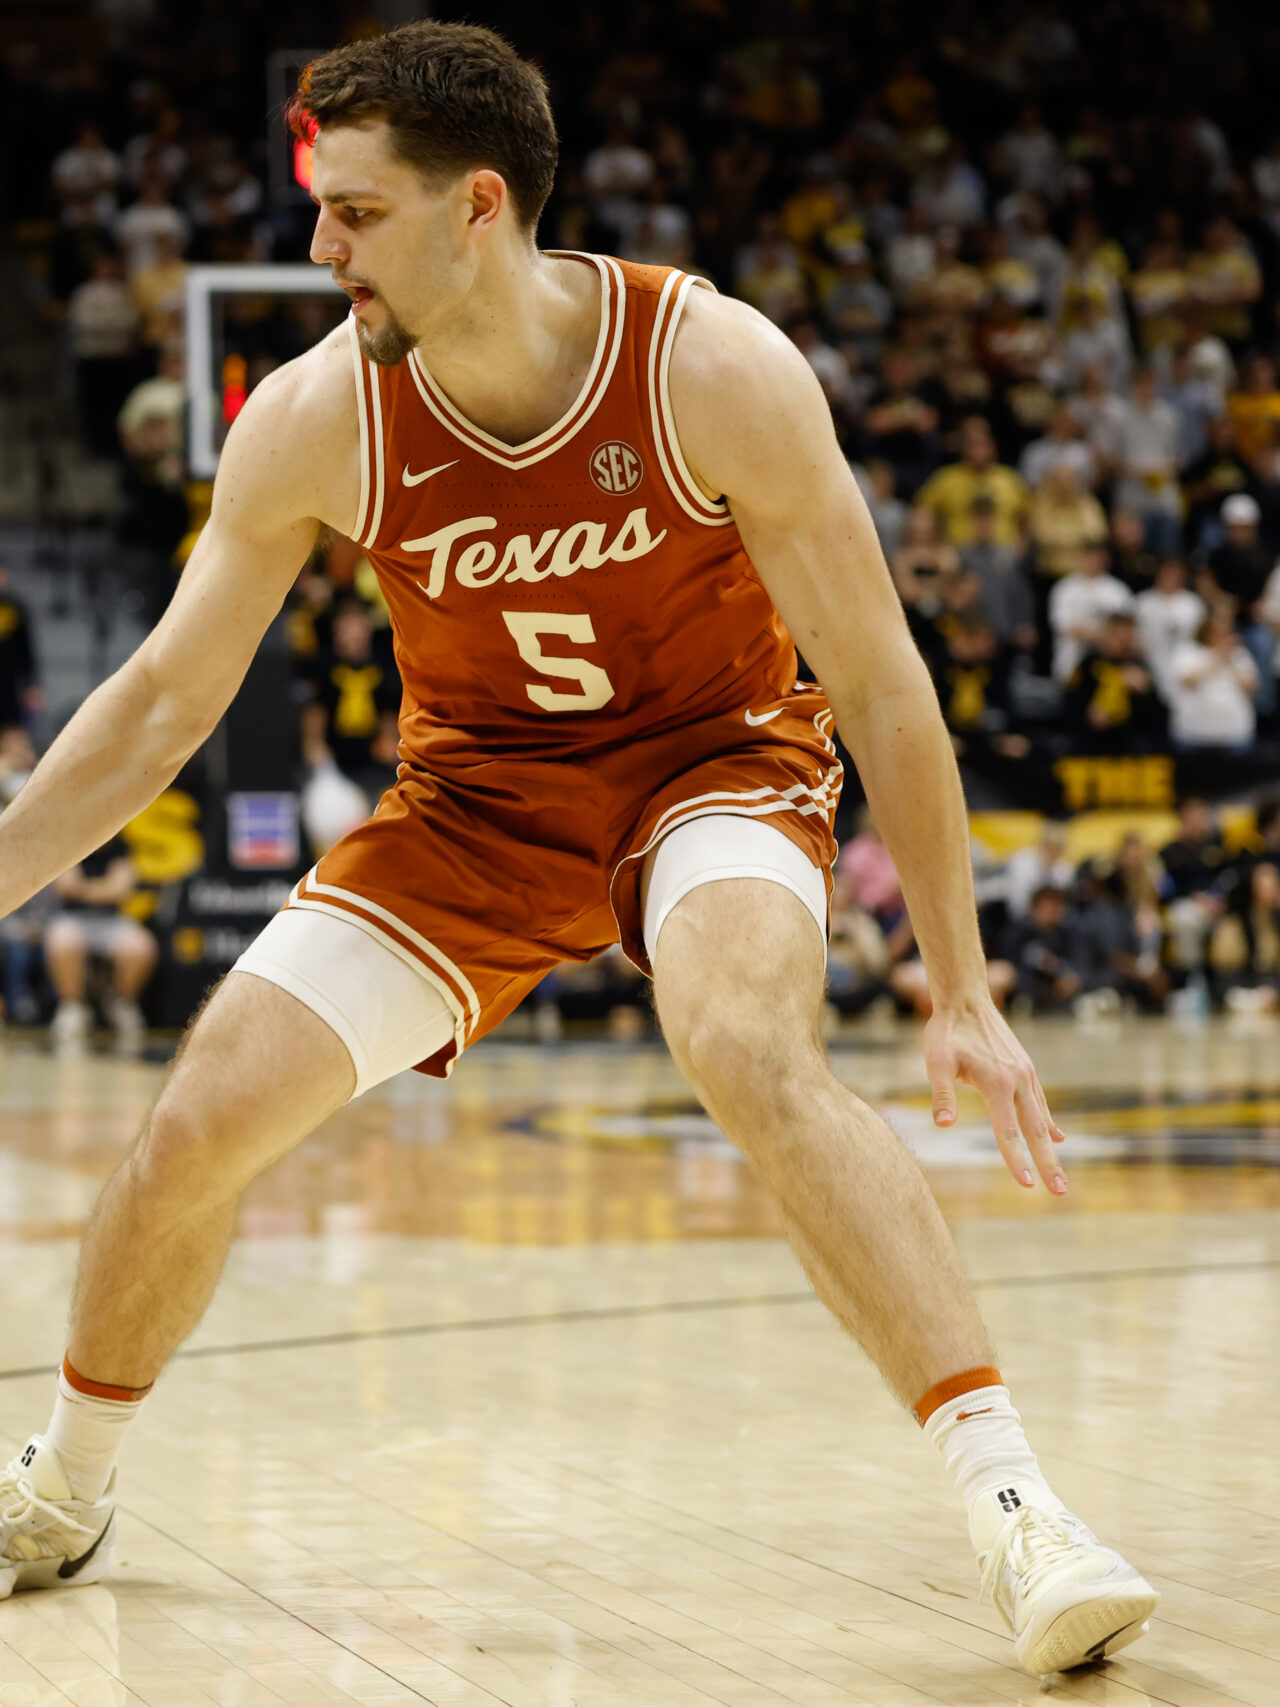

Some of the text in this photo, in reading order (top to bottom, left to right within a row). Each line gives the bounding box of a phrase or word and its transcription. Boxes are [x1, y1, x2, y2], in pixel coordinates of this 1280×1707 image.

[594, 445, 639, 492] SEC
[400, 507, 667, 600] Texas
[501, 610, 615, 712] 5
